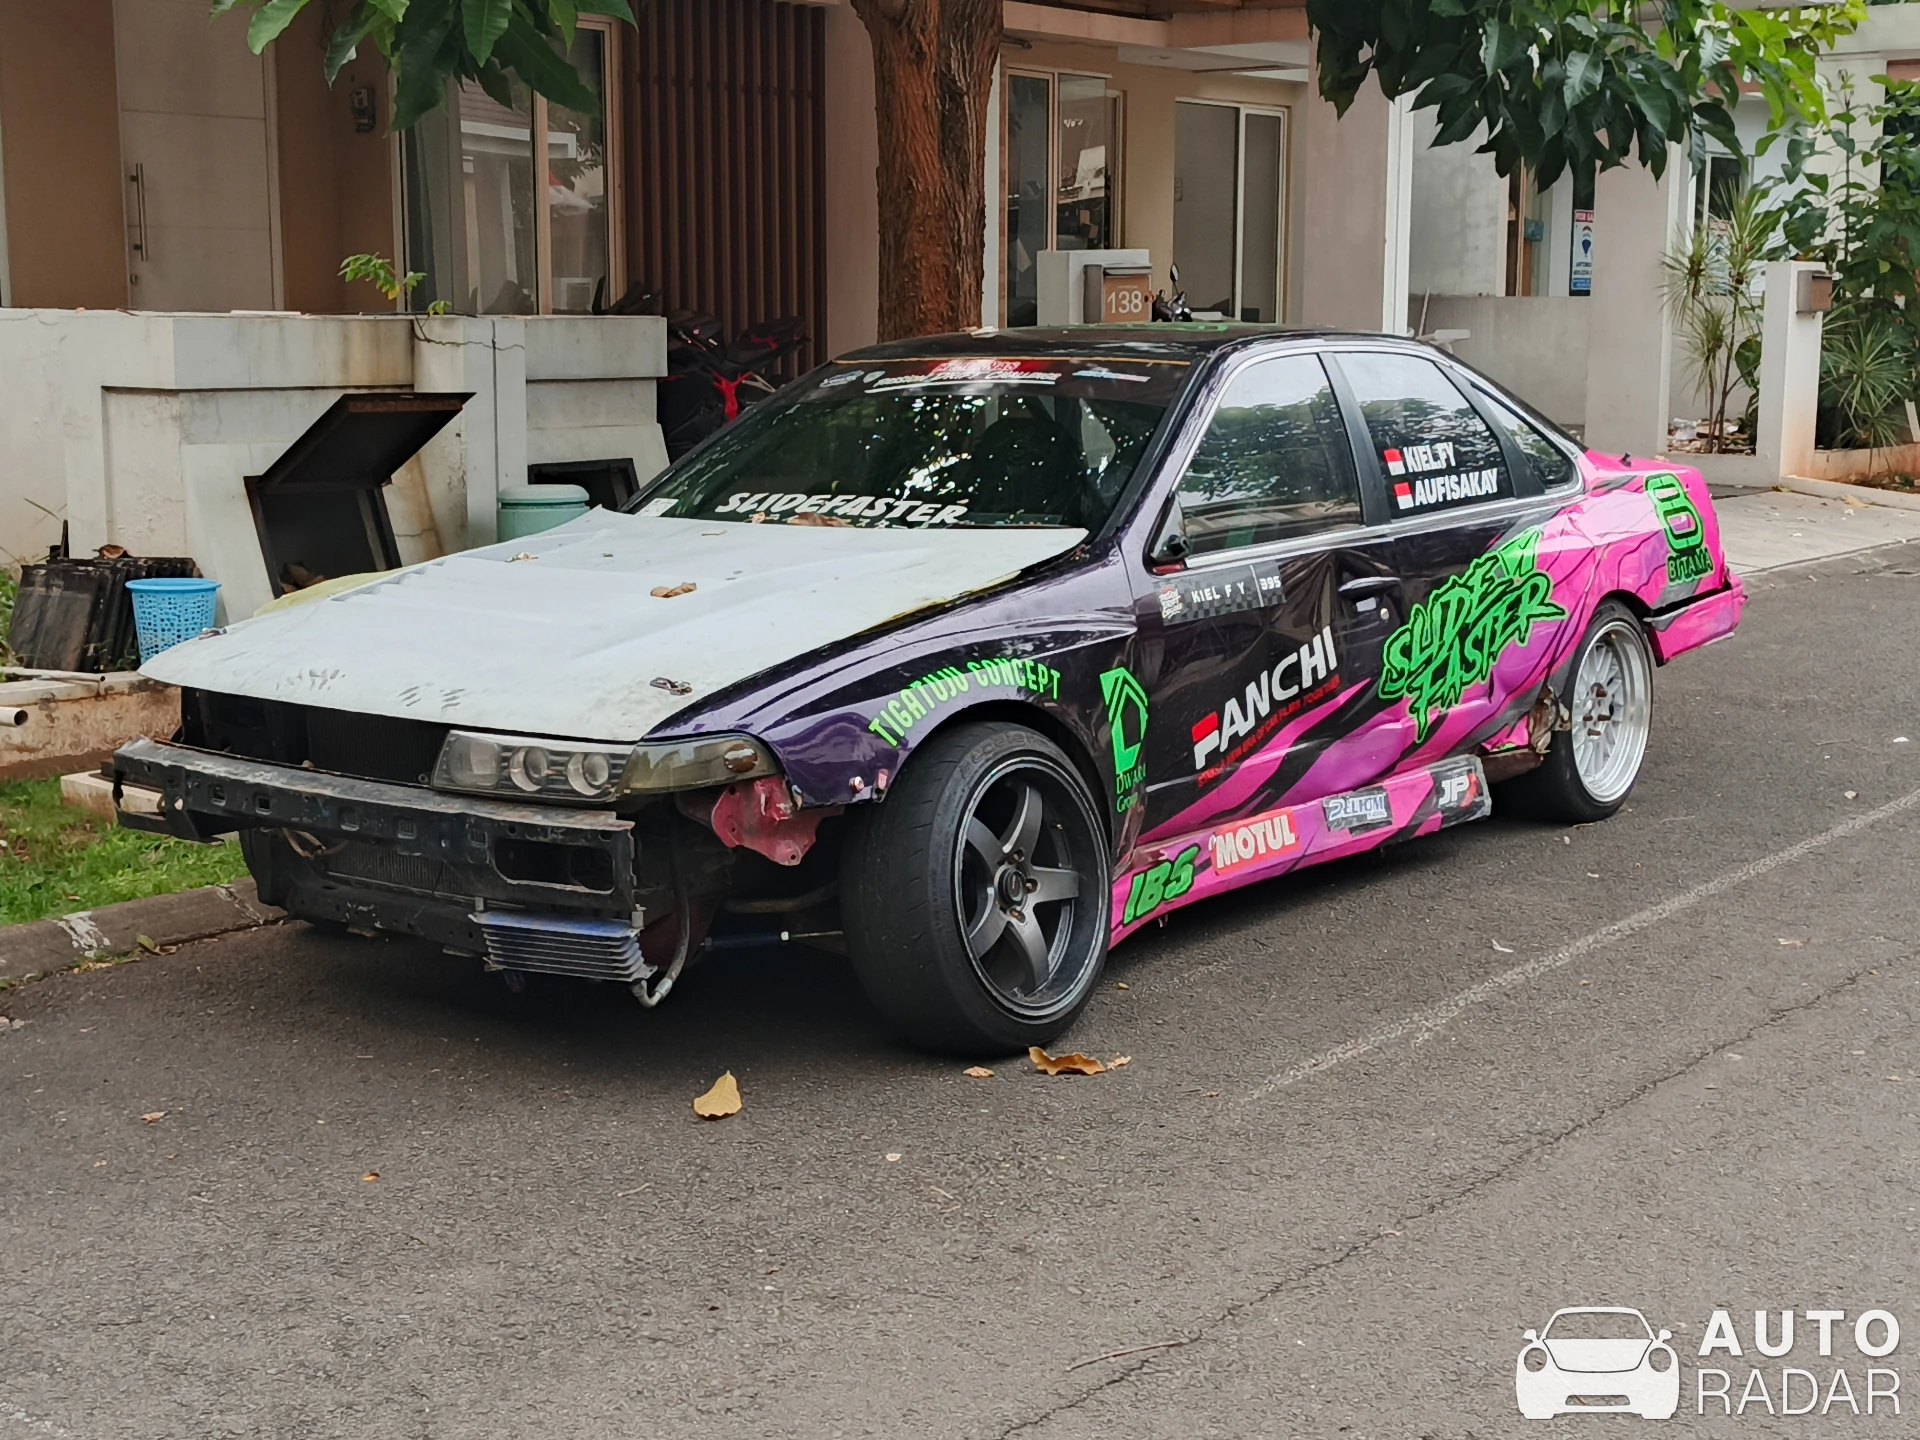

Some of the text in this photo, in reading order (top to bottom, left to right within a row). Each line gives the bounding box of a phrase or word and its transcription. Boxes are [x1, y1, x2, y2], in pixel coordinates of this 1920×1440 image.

[1107, 291, 1142, 313] 138
[714, 492, 969, 524] SLIDEFASTER
[1415, 467, 1498, 506] AUFISAKAY
[1407, 572, 1566, 743] FASTER
[868, 657, 1061, 747] TIGATUJU CONCEPT
[1191, 625, 1338, 770] FANCHI
[1215, 814, 1296, 869] MOTUL
[1123, 844, 1201, 925] IBS
